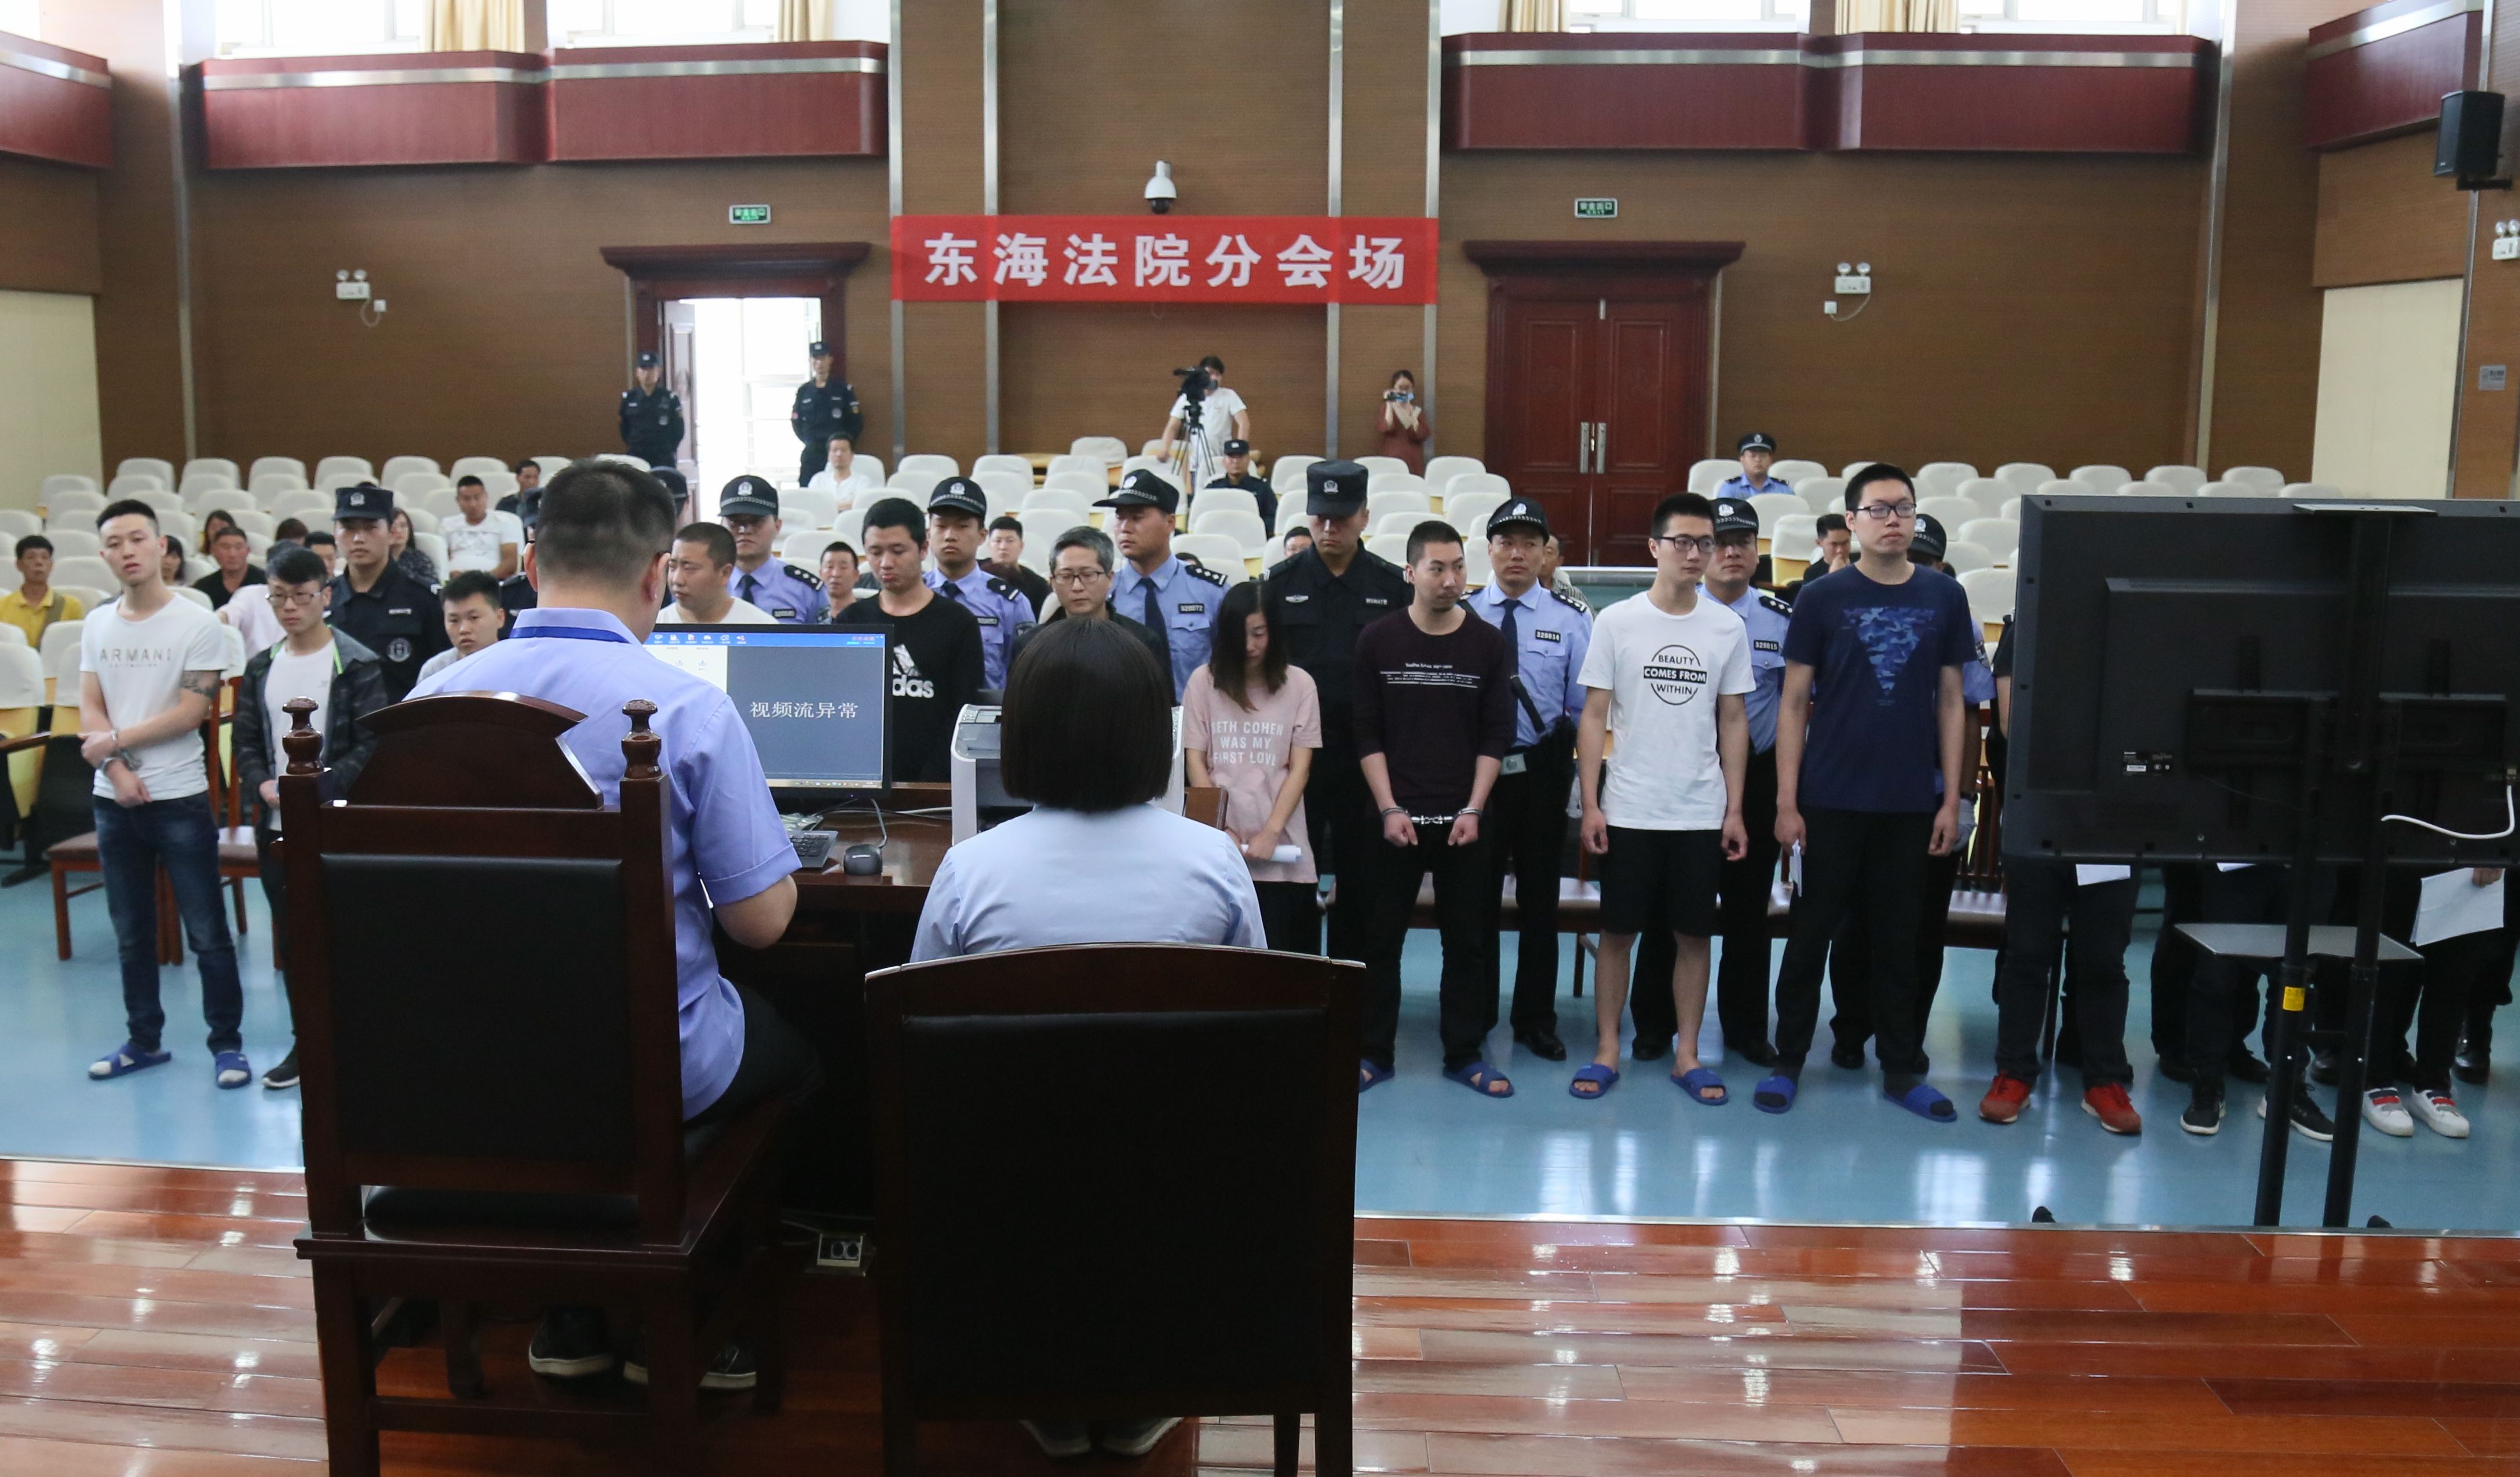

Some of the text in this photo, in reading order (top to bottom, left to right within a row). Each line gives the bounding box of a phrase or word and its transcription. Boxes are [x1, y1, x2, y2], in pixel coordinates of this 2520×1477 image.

[924, 233, 1407, 288] 东海法院分会场
[100, 648, 171, 661] ARMANI
[1658, 655, 1694, 665] BEAUTY
[1645, 668, 1706, 682] COMES FROM
[892, 674, 934, 698] das
[1656, 683, 1692, 694] WITHIN
[750, 701, 859, 718] 视频流异常
[1211, 721, 1284, 736] SETH COHEN
[1220, 736, 1271, 750] WAS MY
[1213, 751, 1244, 764] FIRST
